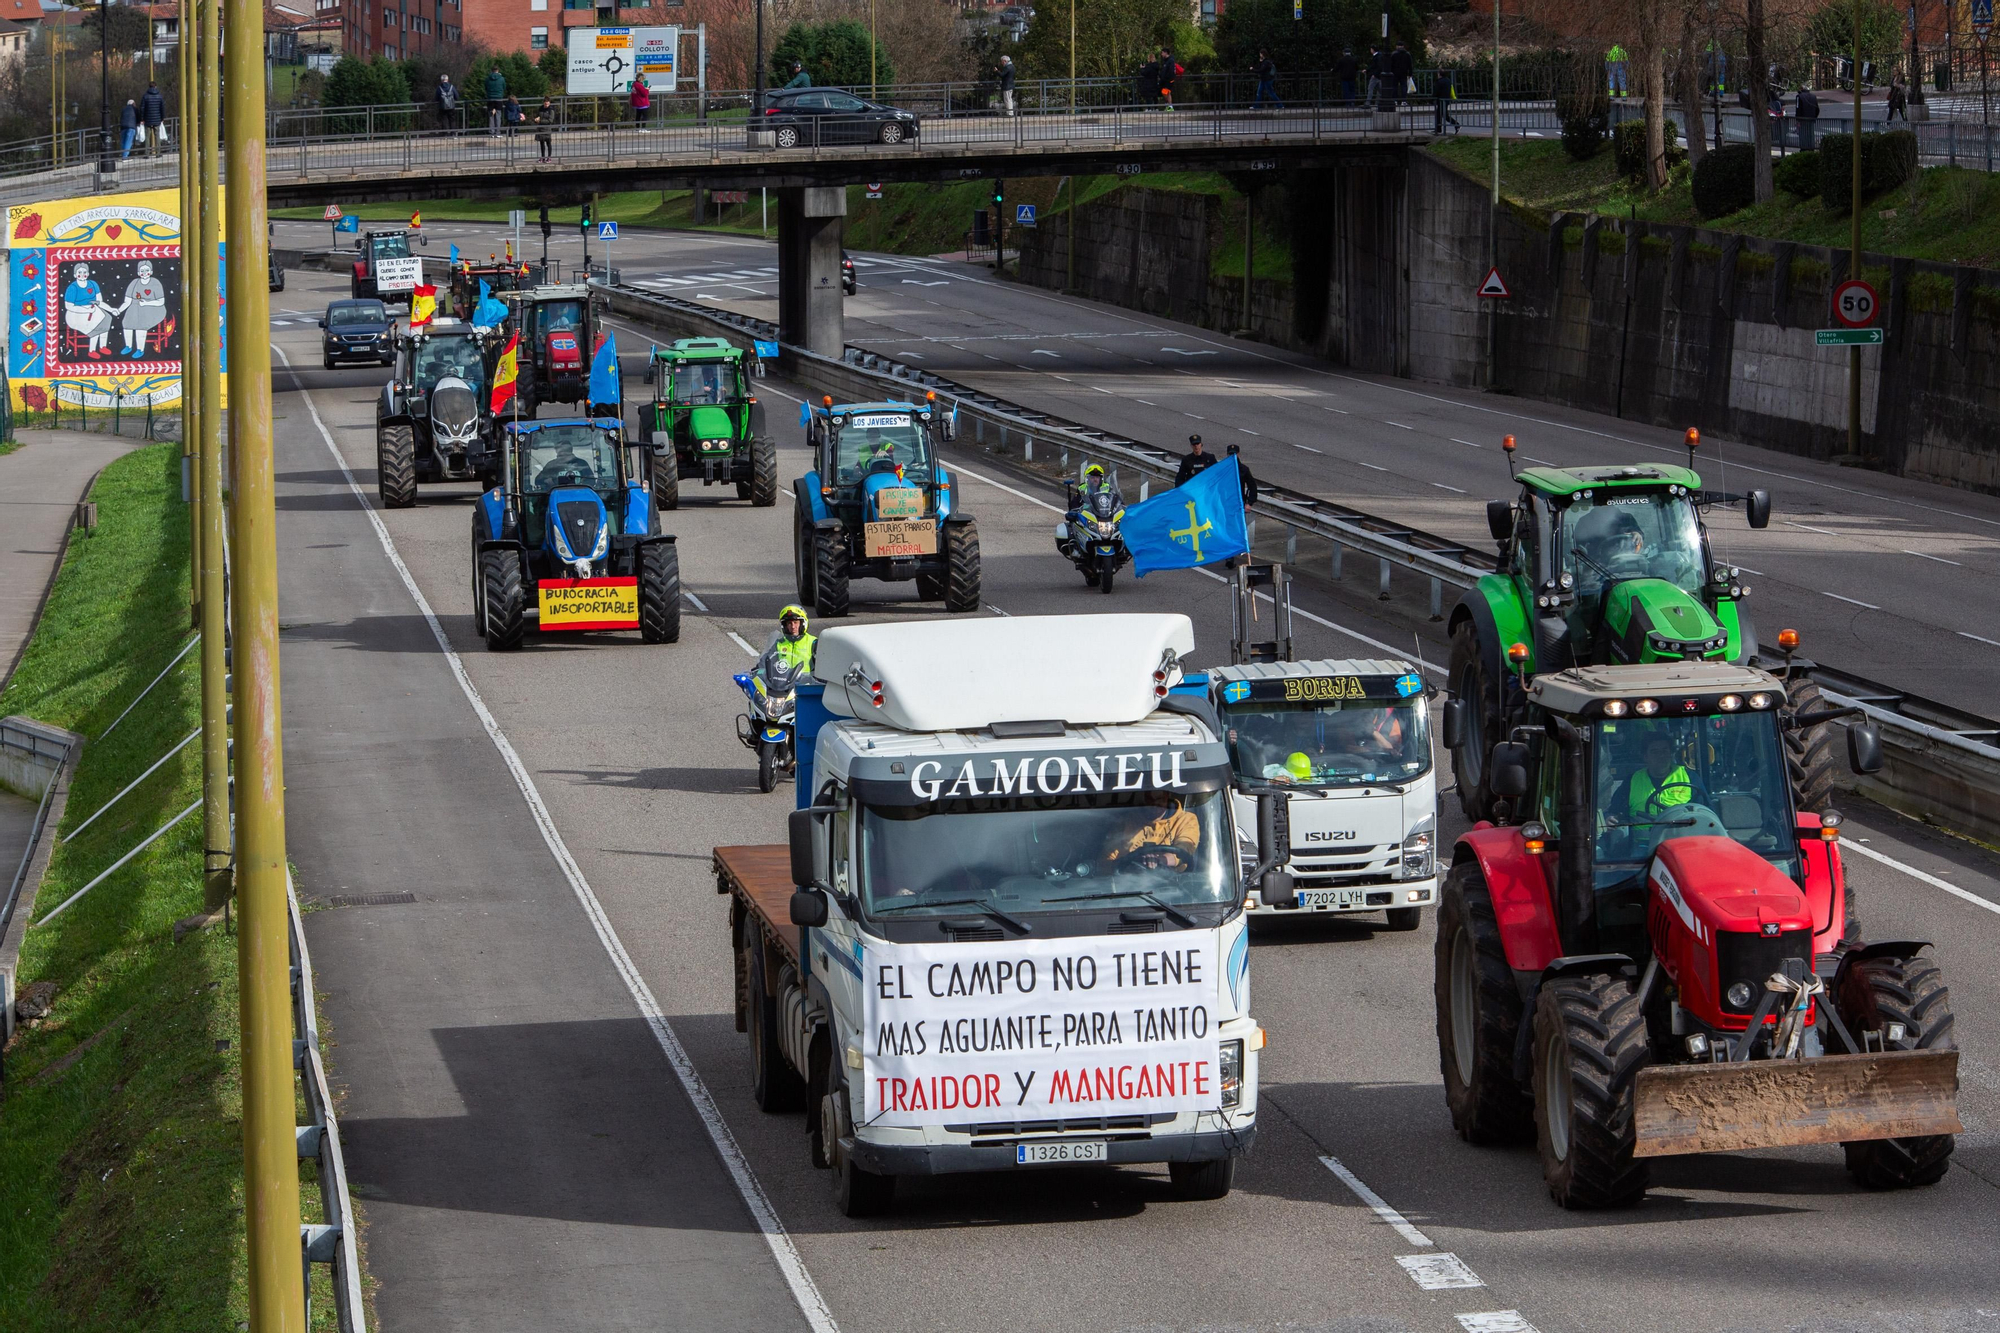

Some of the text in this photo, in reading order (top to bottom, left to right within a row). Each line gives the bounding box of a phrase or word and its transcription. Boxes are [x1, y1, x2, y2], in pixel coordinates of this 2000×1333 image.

[1118, 164, 1140, 173] 4.90
[1252, 161, 1274, 170] 4.95
[1843, 296, 1870, 312] 50
[854, 417, 898, 426] LOS JAVIERES
[886, 491, 919, 499] ASTURIAS
[888, 534, 909, 544] DEL
[877, 544, 925, 555] MATORRAL
[545, 588, 619, 600] BUROCRACIA
[550, 601, 635, 615] INSOPORTABLE
[1284, 677, 1366, 701] BORJA
[910, 751, 1188, 802] GAMONEU
[1305, 830, 1356, 841] ISUZU
[1306, 891, 1362, 905] 7202 LYH
[876, 949, 1202, 999] EL CAMPO NO TIENE
[877, 1020, 927, 1056] MAS
[1133, 1005, 1208, 1042] TANTO
[876, 1061, 1209, 1112] TRAIDOR Y MANGANTE
[1030, 1145, 1068, 1160] 1326
[1074, 1144, 1103, 1159] CST
